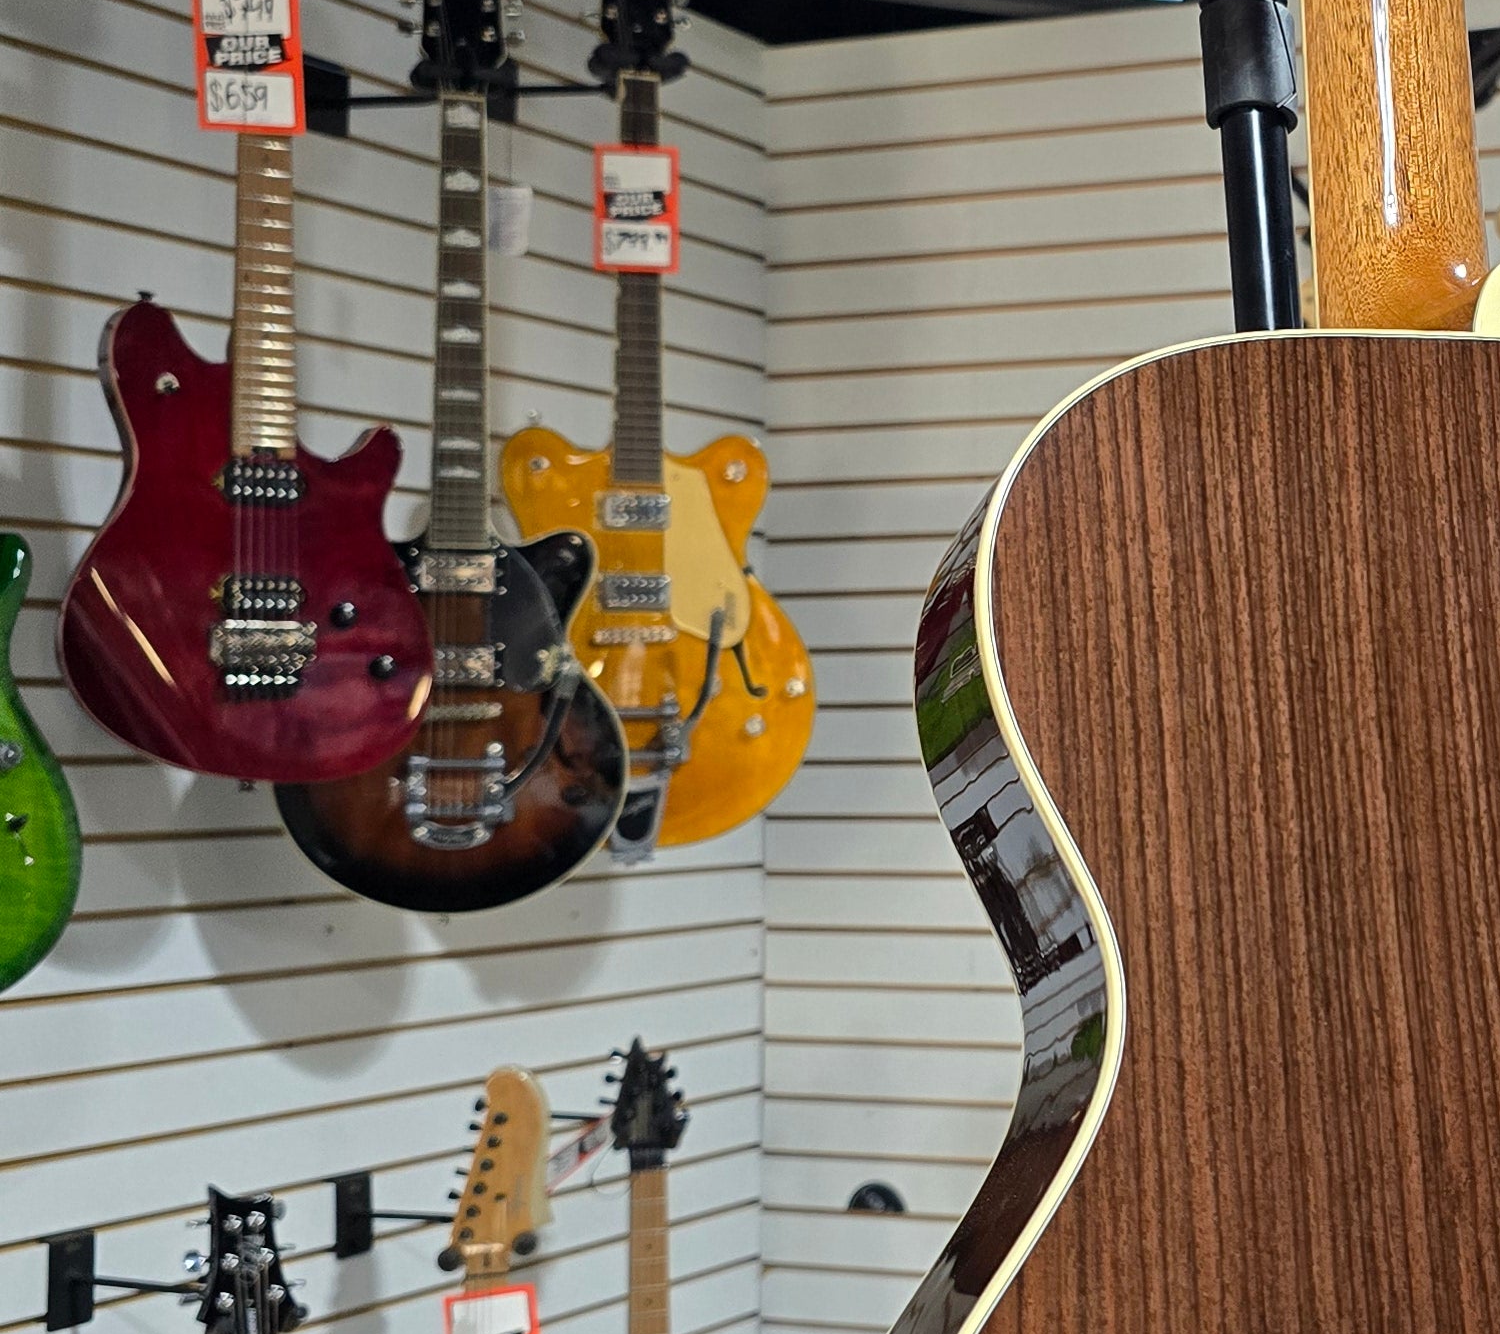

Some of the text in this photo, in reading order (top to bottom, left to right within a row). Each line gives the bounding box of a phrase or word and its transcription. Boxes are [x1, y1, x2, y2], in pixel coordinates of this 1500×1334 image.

[220, 36, 270, 52] OUR
[214, 47, 283, 67] PRICE
[208, 78, 269, 112] $659
